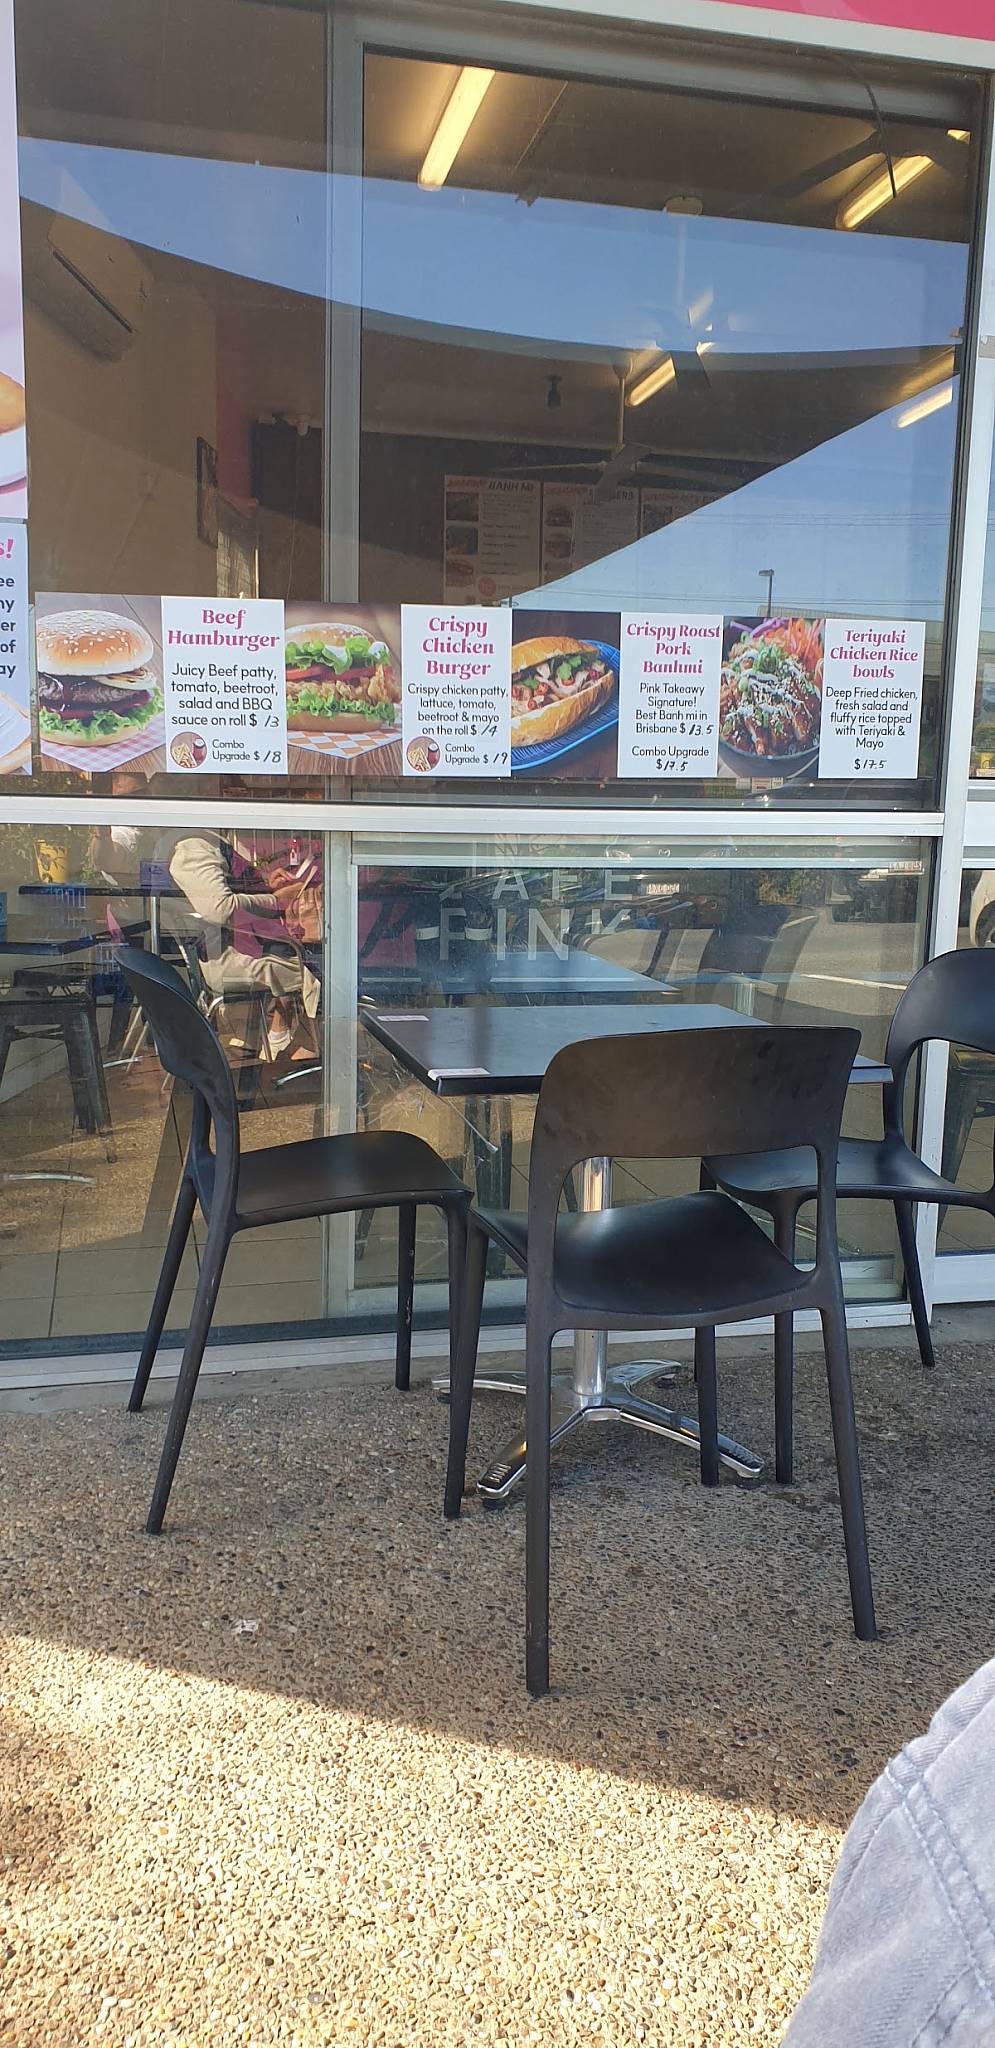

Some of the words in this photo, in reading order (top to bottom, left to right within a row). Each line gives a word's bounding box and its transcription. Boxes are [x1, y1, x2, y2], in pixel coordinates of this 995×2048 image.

[202, 609, 247, 630] Beef
[428, 615, 488, 638] Crispy
[627, 621, 676, 641] Crispy
[680, 624, 720, 637] Roast
[168, 630, 280, 652] Hamburger
[845, 629, 907, 646] Teriyaki
[1, 640, 16, 653] of
[422, 637, 494, 654] Chicken
[656, 642, 691, 655] Pork
[830, 646, 887, 661] Chicken
[889, 648, 918, 661] Rice
[172, 663, 205, 680] Juicy
[208, 664, 238, 677] Beef
[241, 666, 277, 681] patty,
[427, 660, 491, 680] Burger
[643, 659, 703, 673] Banhmi
[853, 665, 895, 679] bowls
[171, 680, 220, 694] tomato,
[223, 681, 278, 696] beetroot,
[407, 683, 440, 697] Crispy
[442, 684, 478, 695] chicken
[640, 682, 660, 693] Pink
[663, 683, 705, 696] Takeawy
[826, 687, 851, 699] Deep
[854, 687, 879, 698] Fried
[880, 688, 918, 700] chicken,
[179, 697, 212, 709] salad
[216, 698, 239, 710] and
[242, 698, 273, 710] BBQ
[459, 699, 496, 710] tomato,
[648, 696, 697, 709] Signature!
[835, 700, 859, 711] fresh
[862, 701, 888, 711] salad
[890, 701, 909, 711] and
[171, 716, 208, 725] sauce
[211, 716, 227, 726] on
[229, 714, 246, 726] roll
[417, 711, 459, 721] beetroot
[462, 711, 469, 722] &
[472, 715, 500, 725] mayo
[636, 709, 657, 720] Best
[659, 710, 683, 720] Banh
[686, 711, 697, 720] mi
[700, 711, 707, 720] in
[830, 712, 857, 725] fluffy
[858, 713, 876, 723] rice
[878, 714, 912, 728] topped
[422, 727, 434, 735] on
[437, 725, 452, 735] the
[455, 725, 468, 735] roll
[636, 723, 677, 733] Brisbane
[835, 725, 856, 736] with
[859, 725, 896, 738] Teriyaki
[897, 726, 906, 736] &
[212, 739, 244, 748] Combo
[445, 743, 475, 752] Combo
[856, 738, 884, 751] Mayo
[212, 751, 251, 762] Upgrade
[632, 746, 666, 756] Combo
[668, 746, 709, 758] Upgrade
[445, 754, 480, 765] Upgrade
